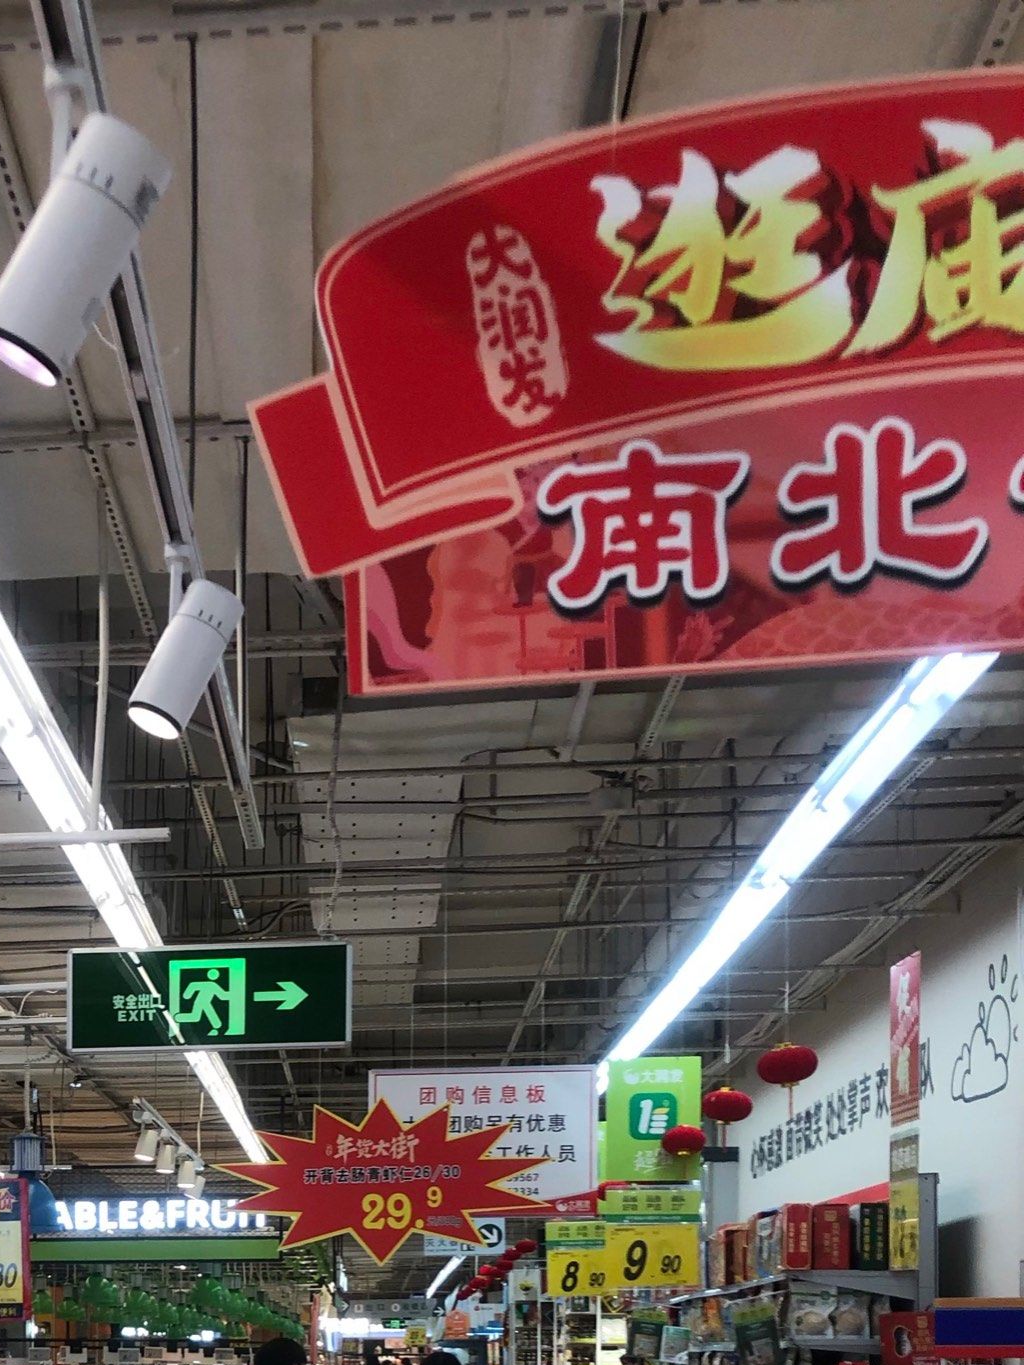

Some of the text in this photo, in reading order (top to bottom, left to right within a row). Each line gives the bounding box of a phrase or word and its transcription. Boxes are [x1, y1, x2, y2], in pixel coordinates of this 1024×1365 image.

[466, 225, 568, 427] 大润发
[537, 418, 1024, 608] 南北
[112, 994, 162, 1009] 安全出口
[117, 1010, 157, 1022] EXIT
[419, 1084, 546, 1105] 团购信息板
[334, 1133, 420, 1163] 年货大街
[485, 1144, 577, 1163] 工作人员
[623, 1239, 682, 1281] 9 90
[561, 1260, 606, 1292] 8 90
